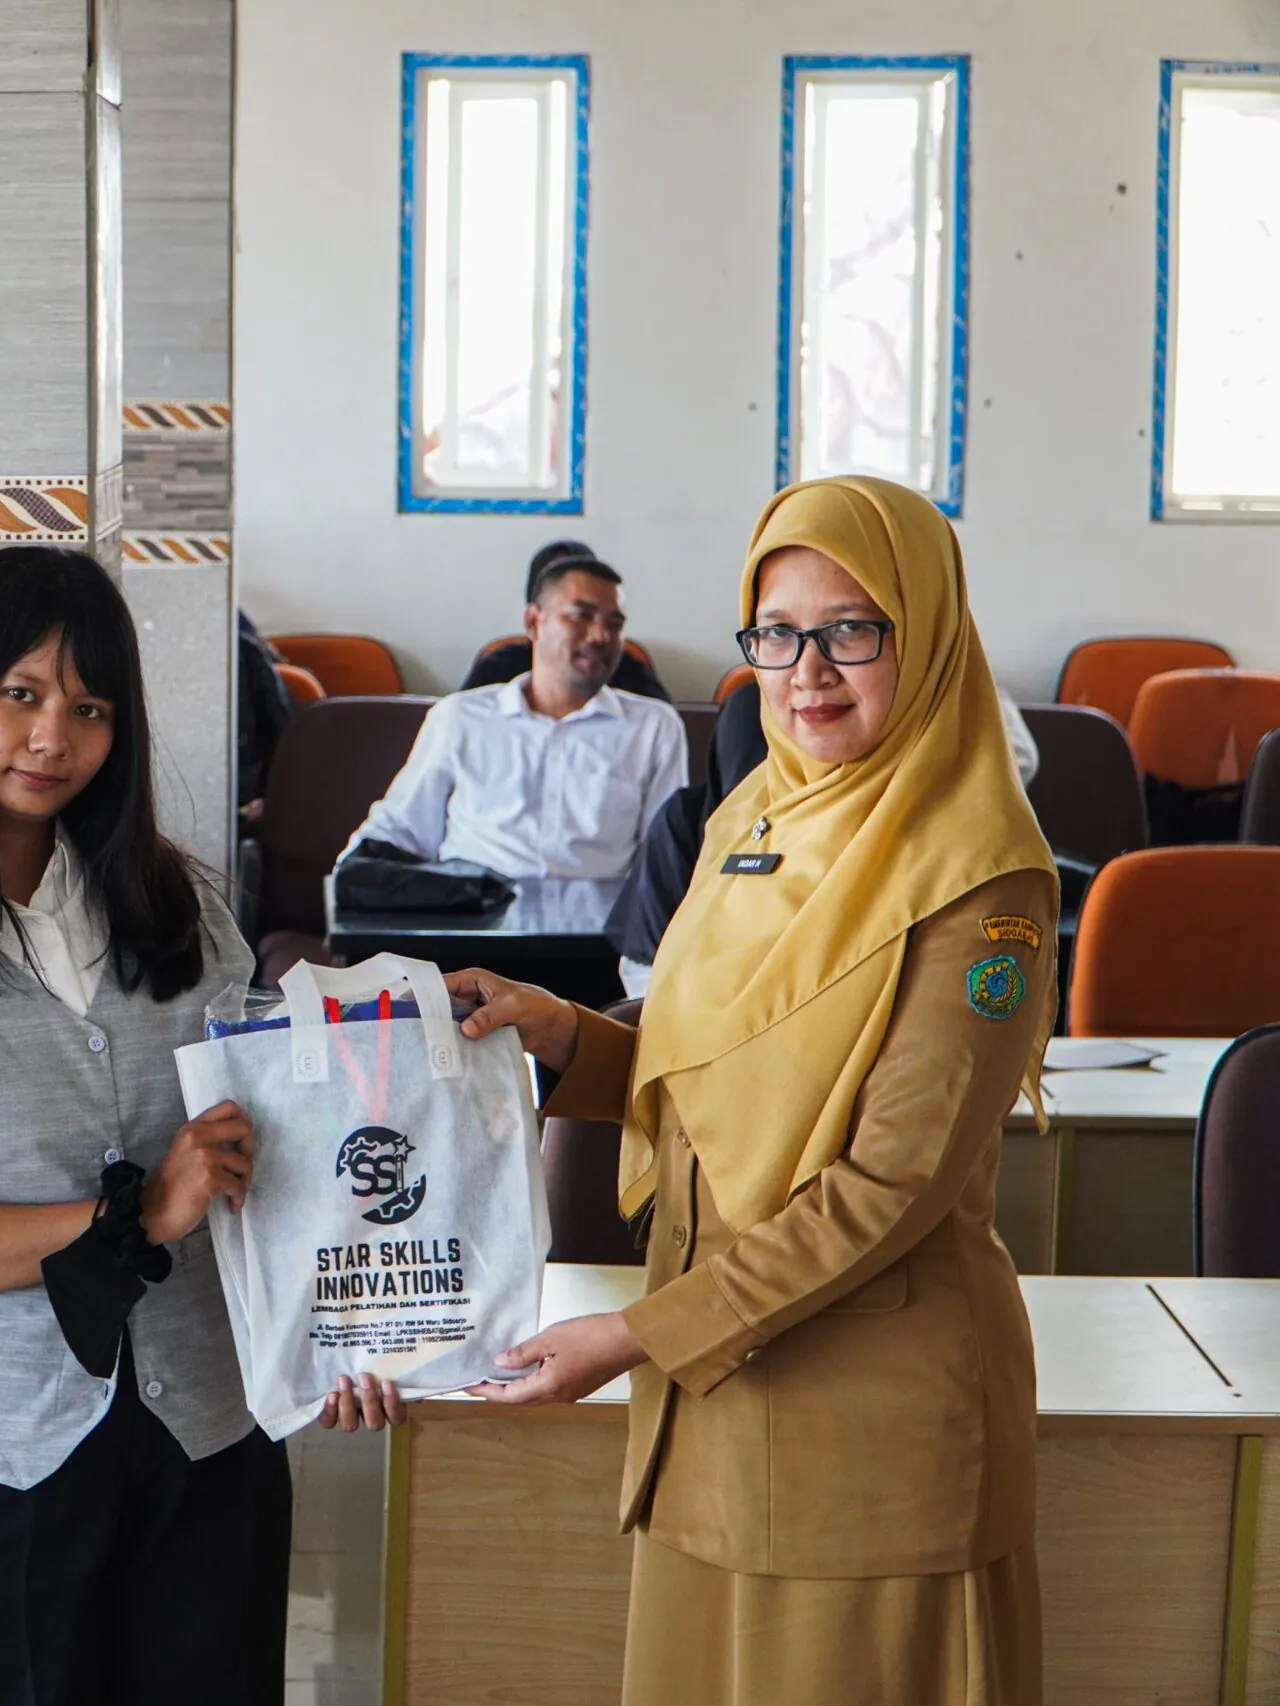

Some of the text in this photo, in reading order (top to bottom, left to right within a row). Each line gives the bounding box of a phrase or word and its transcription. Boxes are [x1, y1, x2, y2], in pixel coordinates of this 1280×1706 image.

[317, 1238, 461, 1272] STAR SKILLS
[316, 1268, 464, 1300] INNOVATIONS
[311, 1304, 349, 1313] LEMBAGA
[350, 1302, 397, 1311] PELATIHAN
[420, 1298, 470, 1307] SERTIFIKASI
